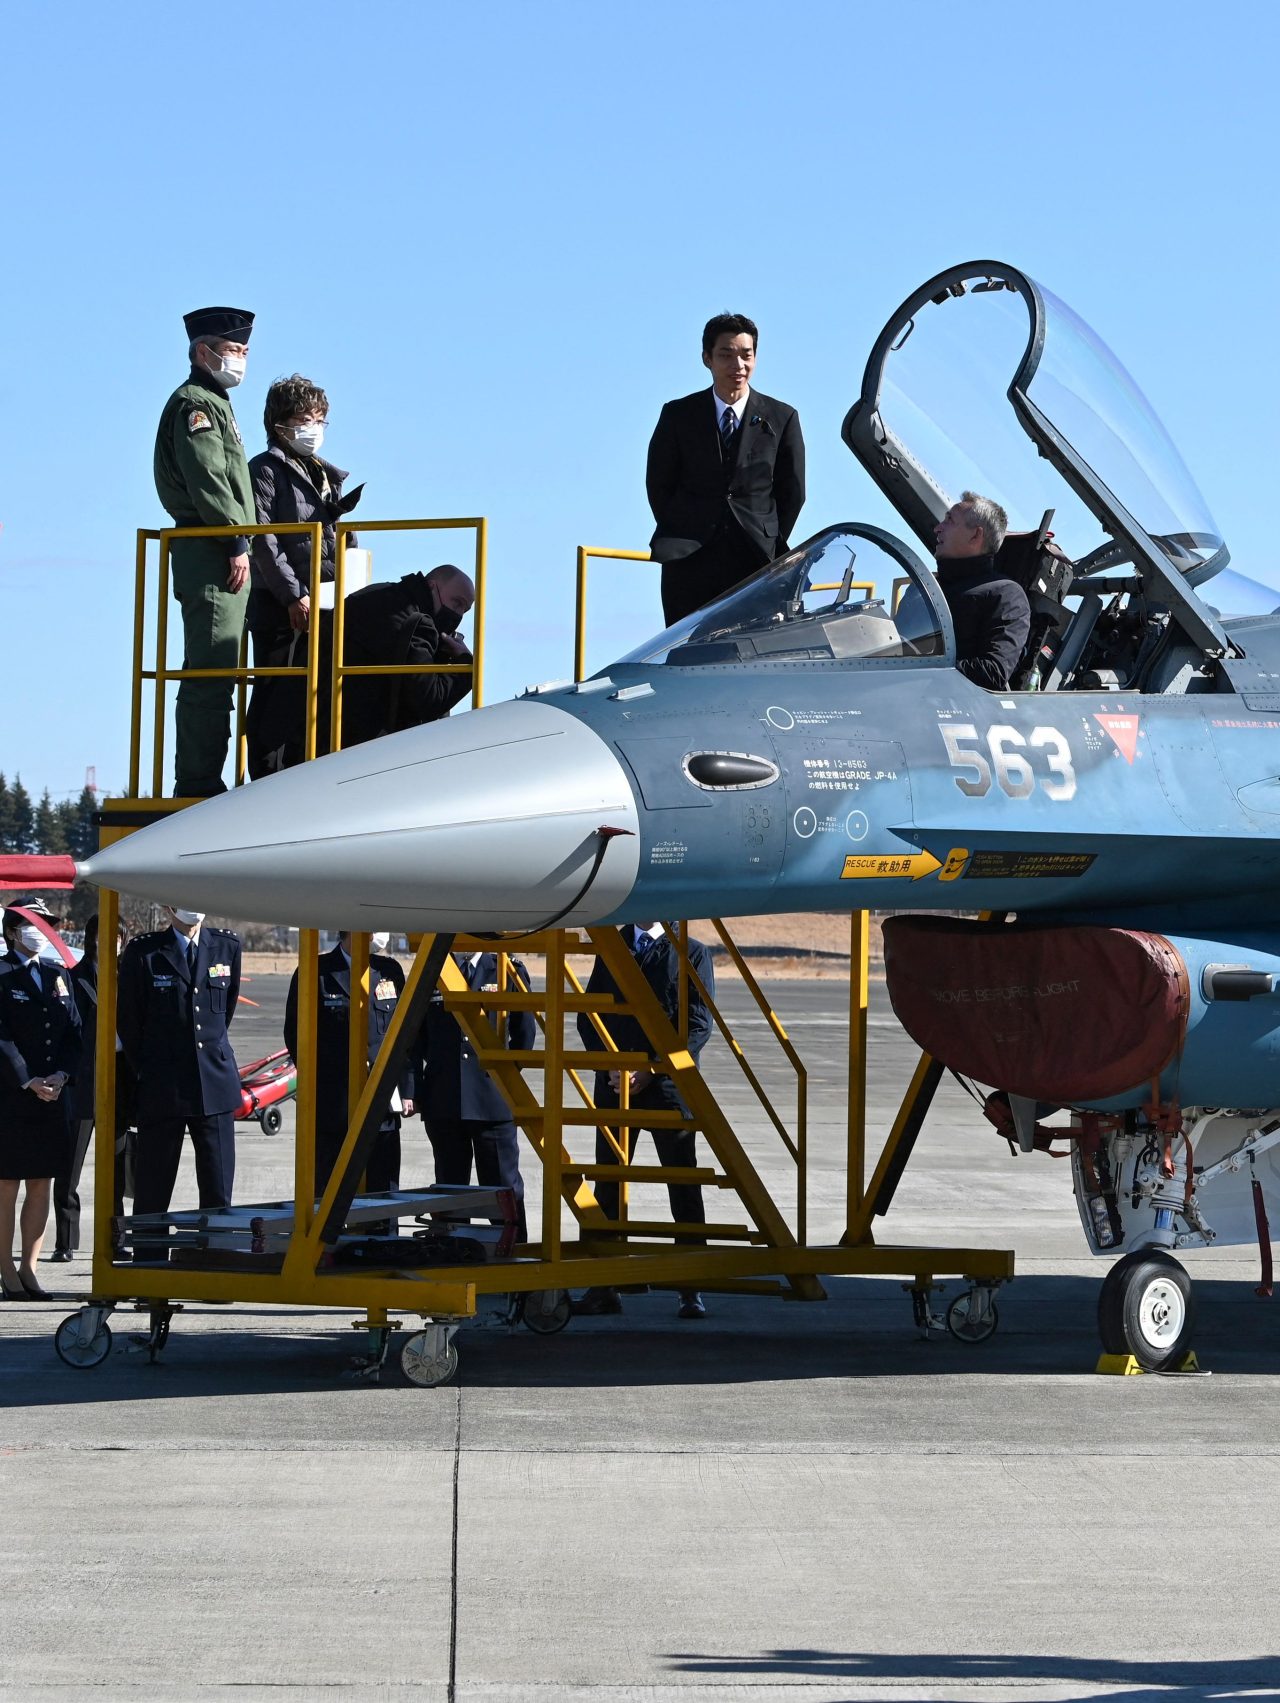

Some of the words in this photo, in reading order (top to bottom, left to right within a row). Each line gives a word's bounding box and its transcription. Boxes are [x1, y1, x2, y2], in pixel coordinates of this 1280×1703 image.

[938, 723, 1077, 801] 563
[874, 771, 898, 780] JP-4A
[845, 859, 877, 868] RESCUE
[877, 859, 912, 873] 救助用
